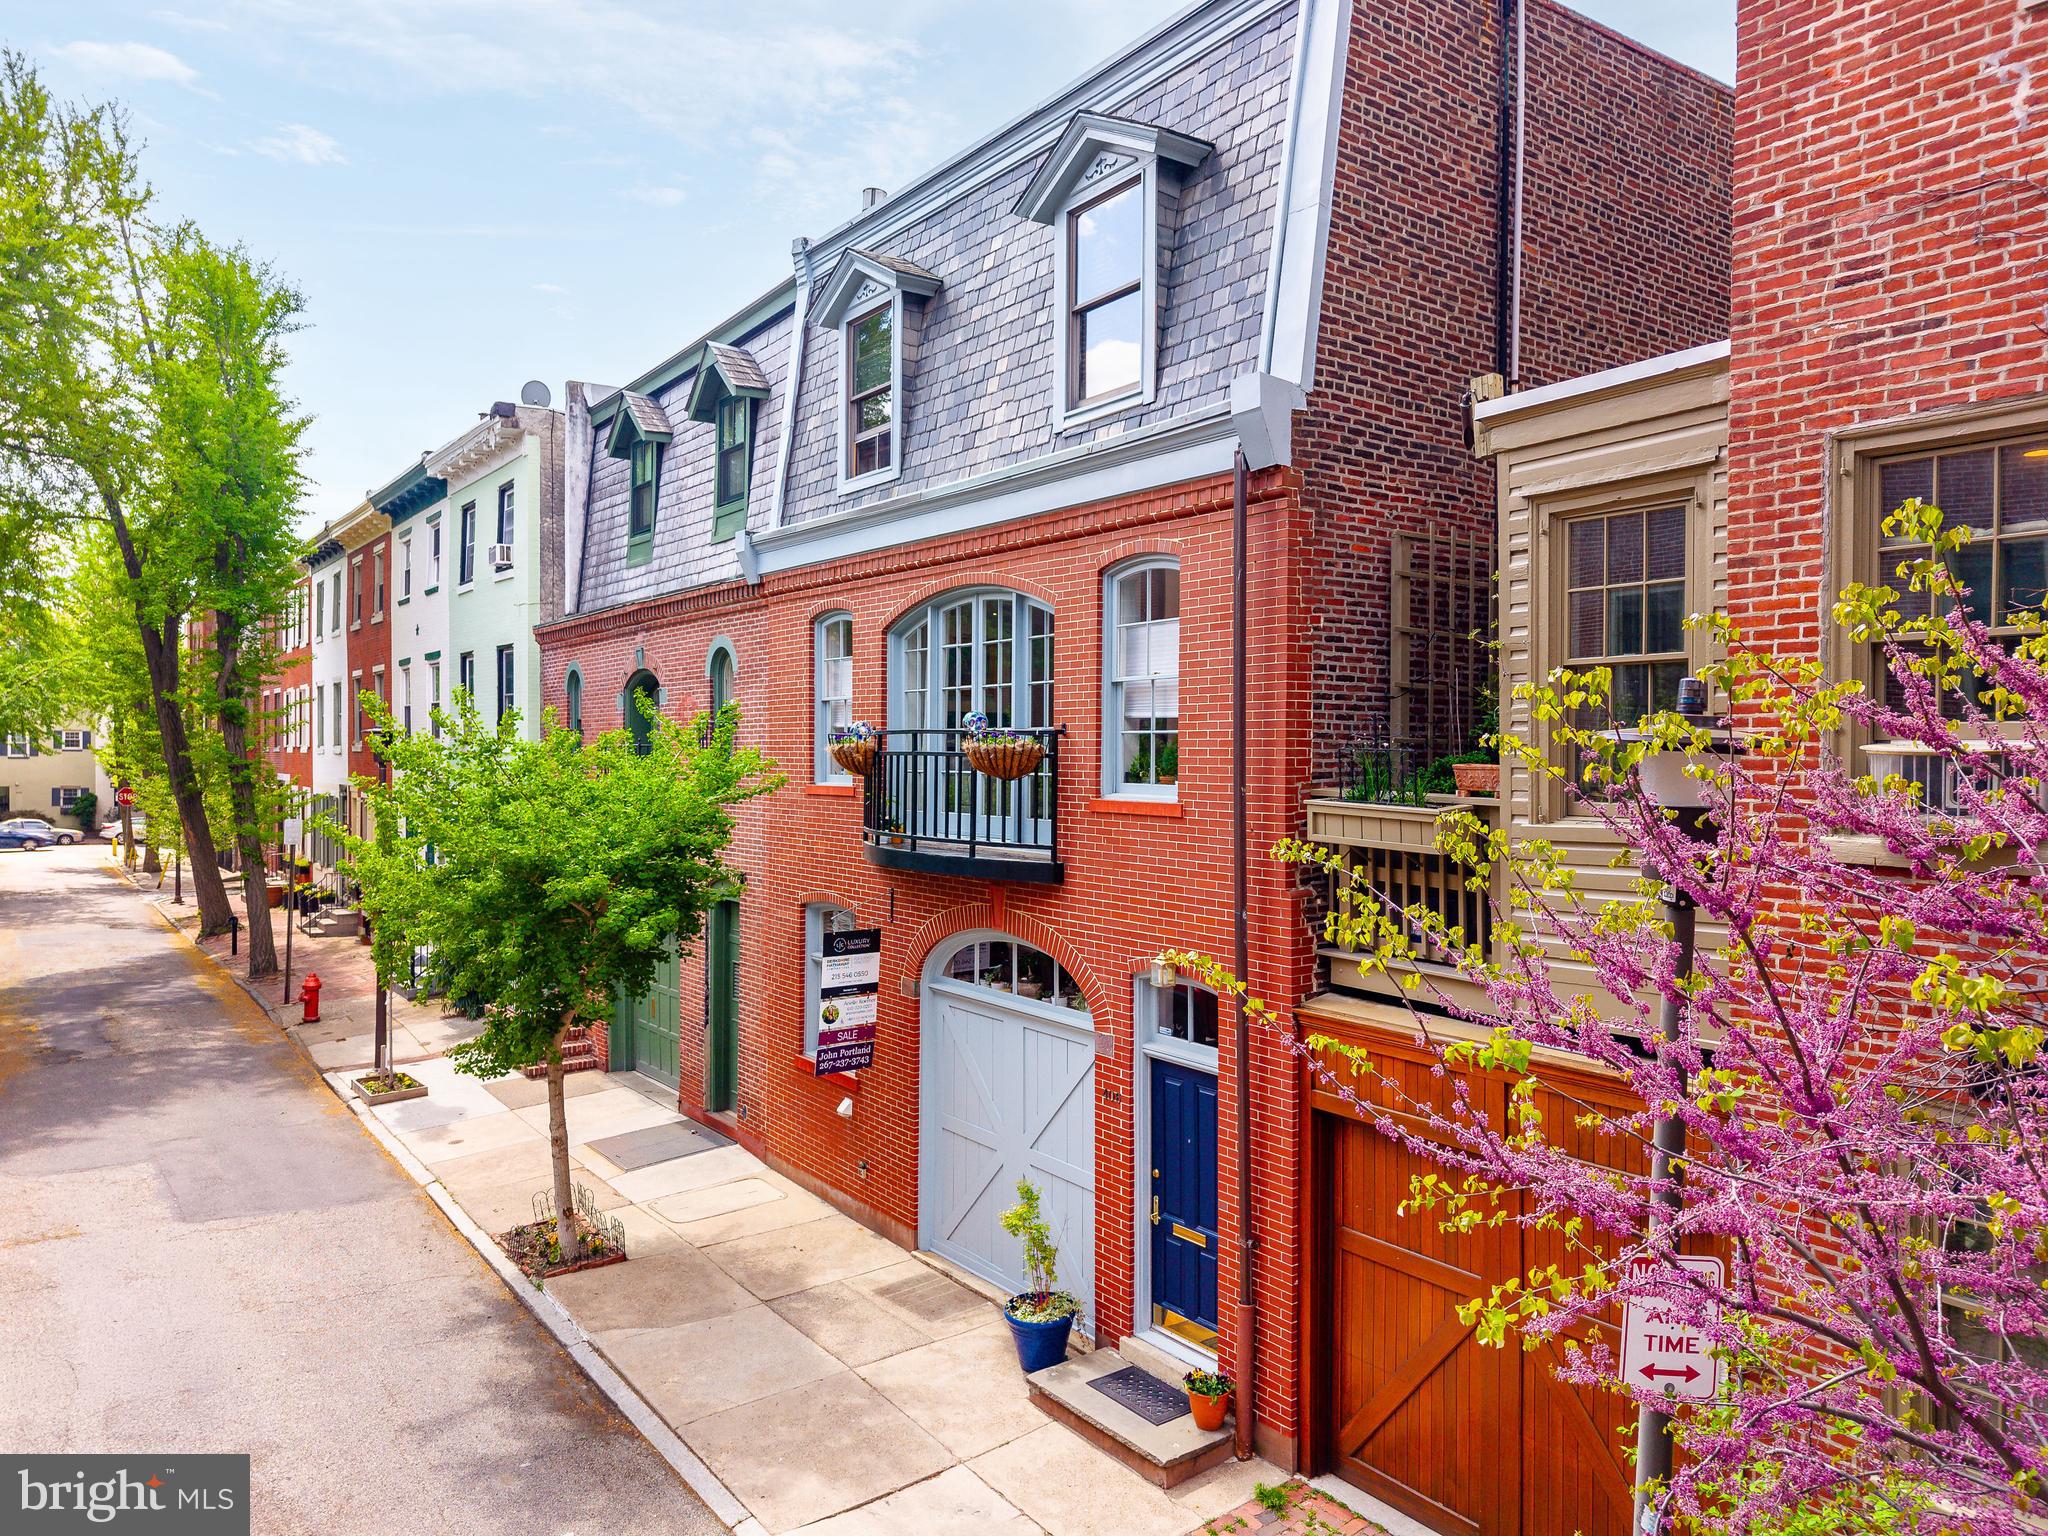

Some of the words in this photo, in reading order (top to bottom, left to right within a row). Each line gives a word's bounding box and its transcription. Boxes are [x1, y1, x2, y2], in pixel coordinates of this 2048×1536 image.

[118, 793, 138, 801] STOP
[847, 938, 871, 946] LUXURY
[837, 1030, 859, 1041] SALE
[818, 1051, 838, 1061] John
[839, 1045, 871, 1057] Portland
[819, 1056, 870, 1070] 267-237-3743
[1643, 1334, 1700, 1354] TIME
